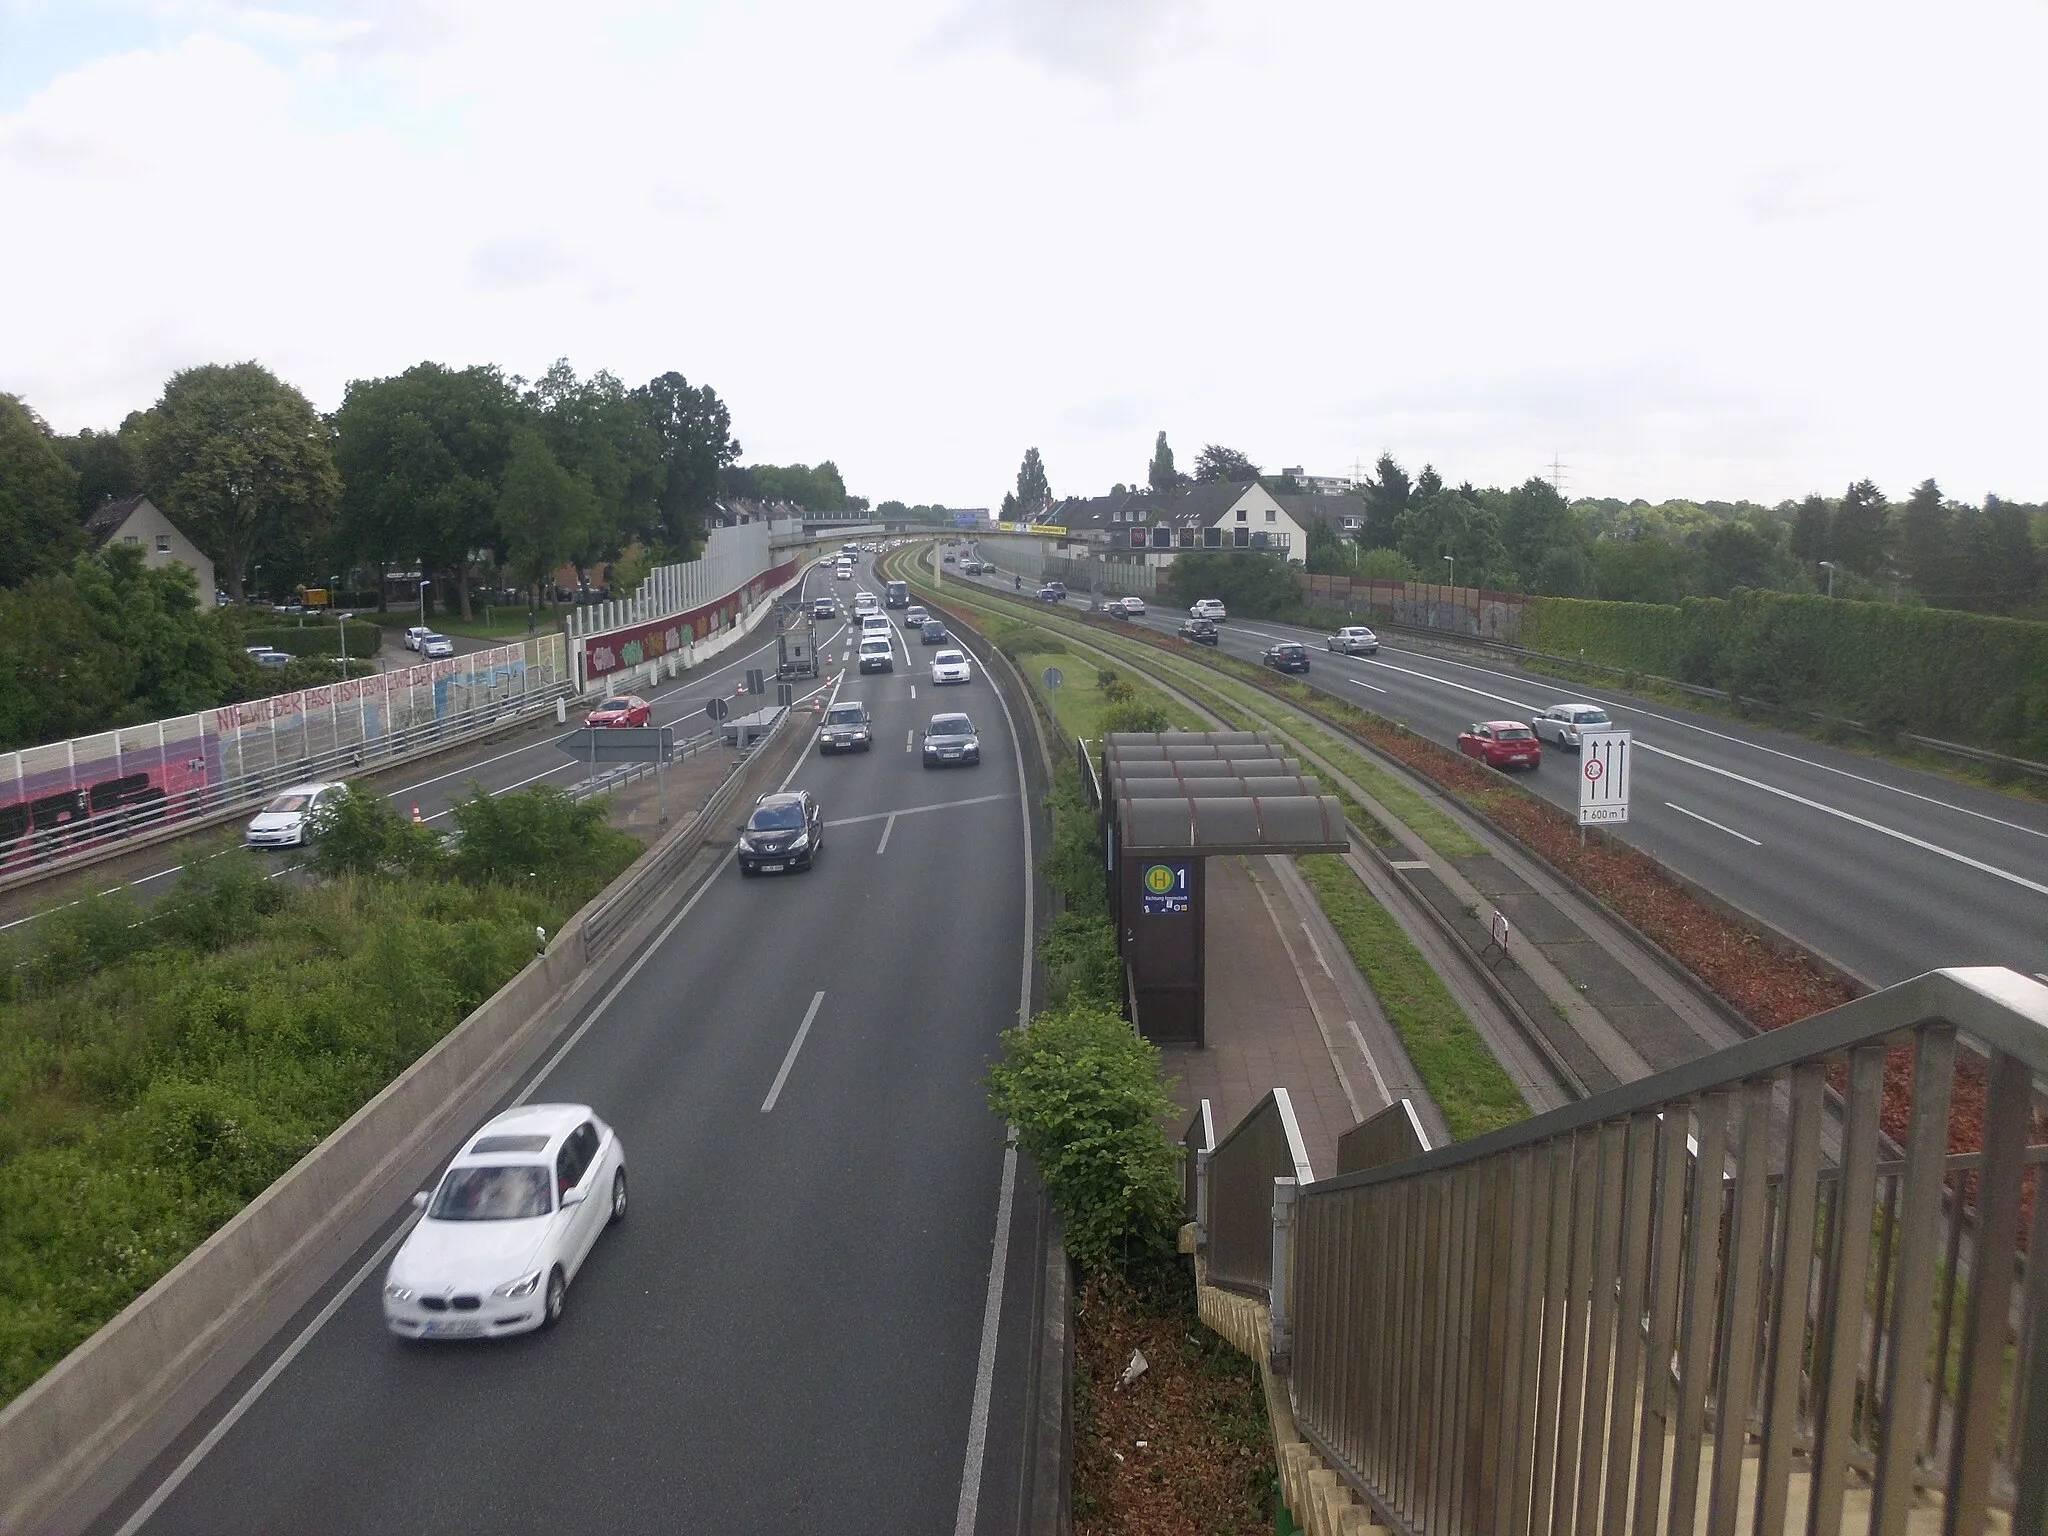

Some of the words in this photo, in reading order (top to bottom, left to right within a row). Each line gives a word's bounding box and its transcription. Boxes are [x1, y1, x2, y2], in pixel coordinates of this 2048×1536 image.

[1591, 810, 1607, 820] 600
[1609, 811, 1618, 819] m
[1154, 872, 1166, 888] H
[1177, 869, 1185, 889] 1
